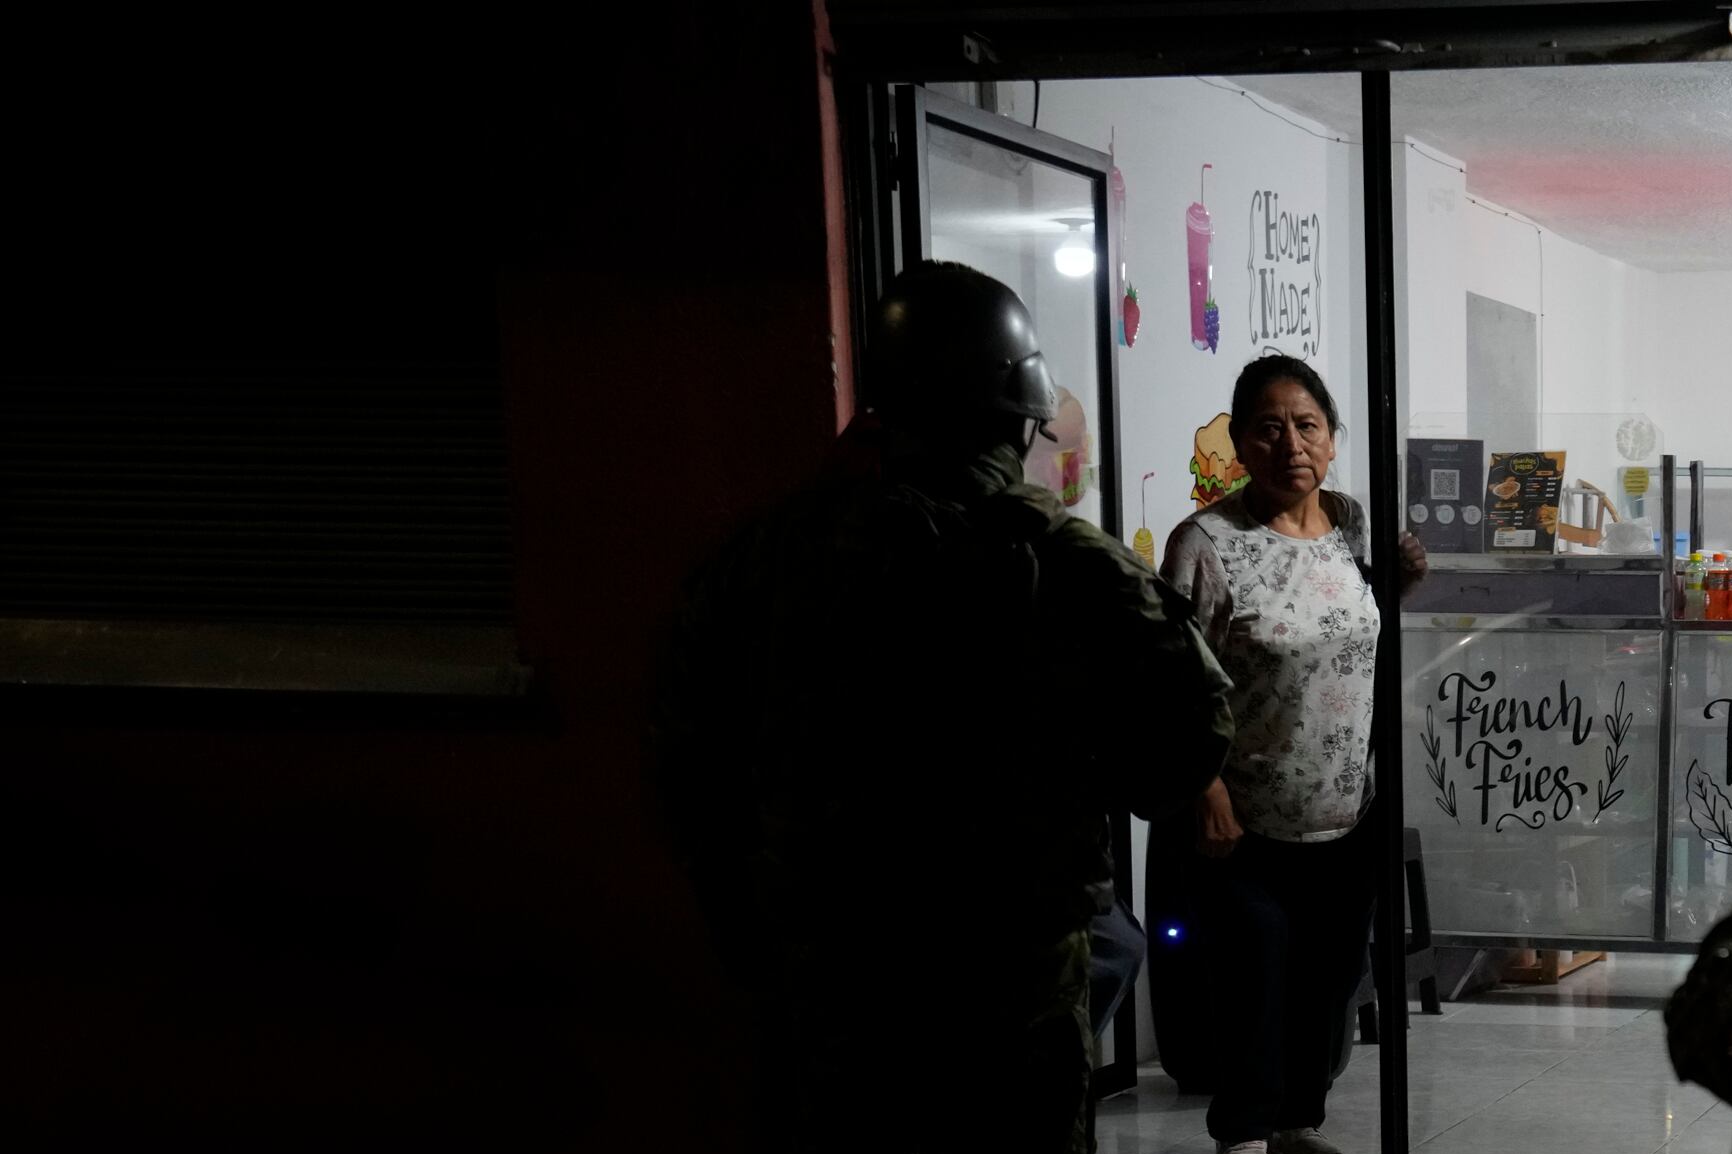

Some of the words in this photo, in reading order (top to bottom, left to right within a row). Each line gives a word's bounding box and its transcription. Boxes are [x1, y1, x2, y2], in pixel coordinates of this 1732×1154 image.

[1258, 268, 1312, 339] MADE
[1438, 671, 1593, 757] French
[1465, 739, 1588, 825] Fries
